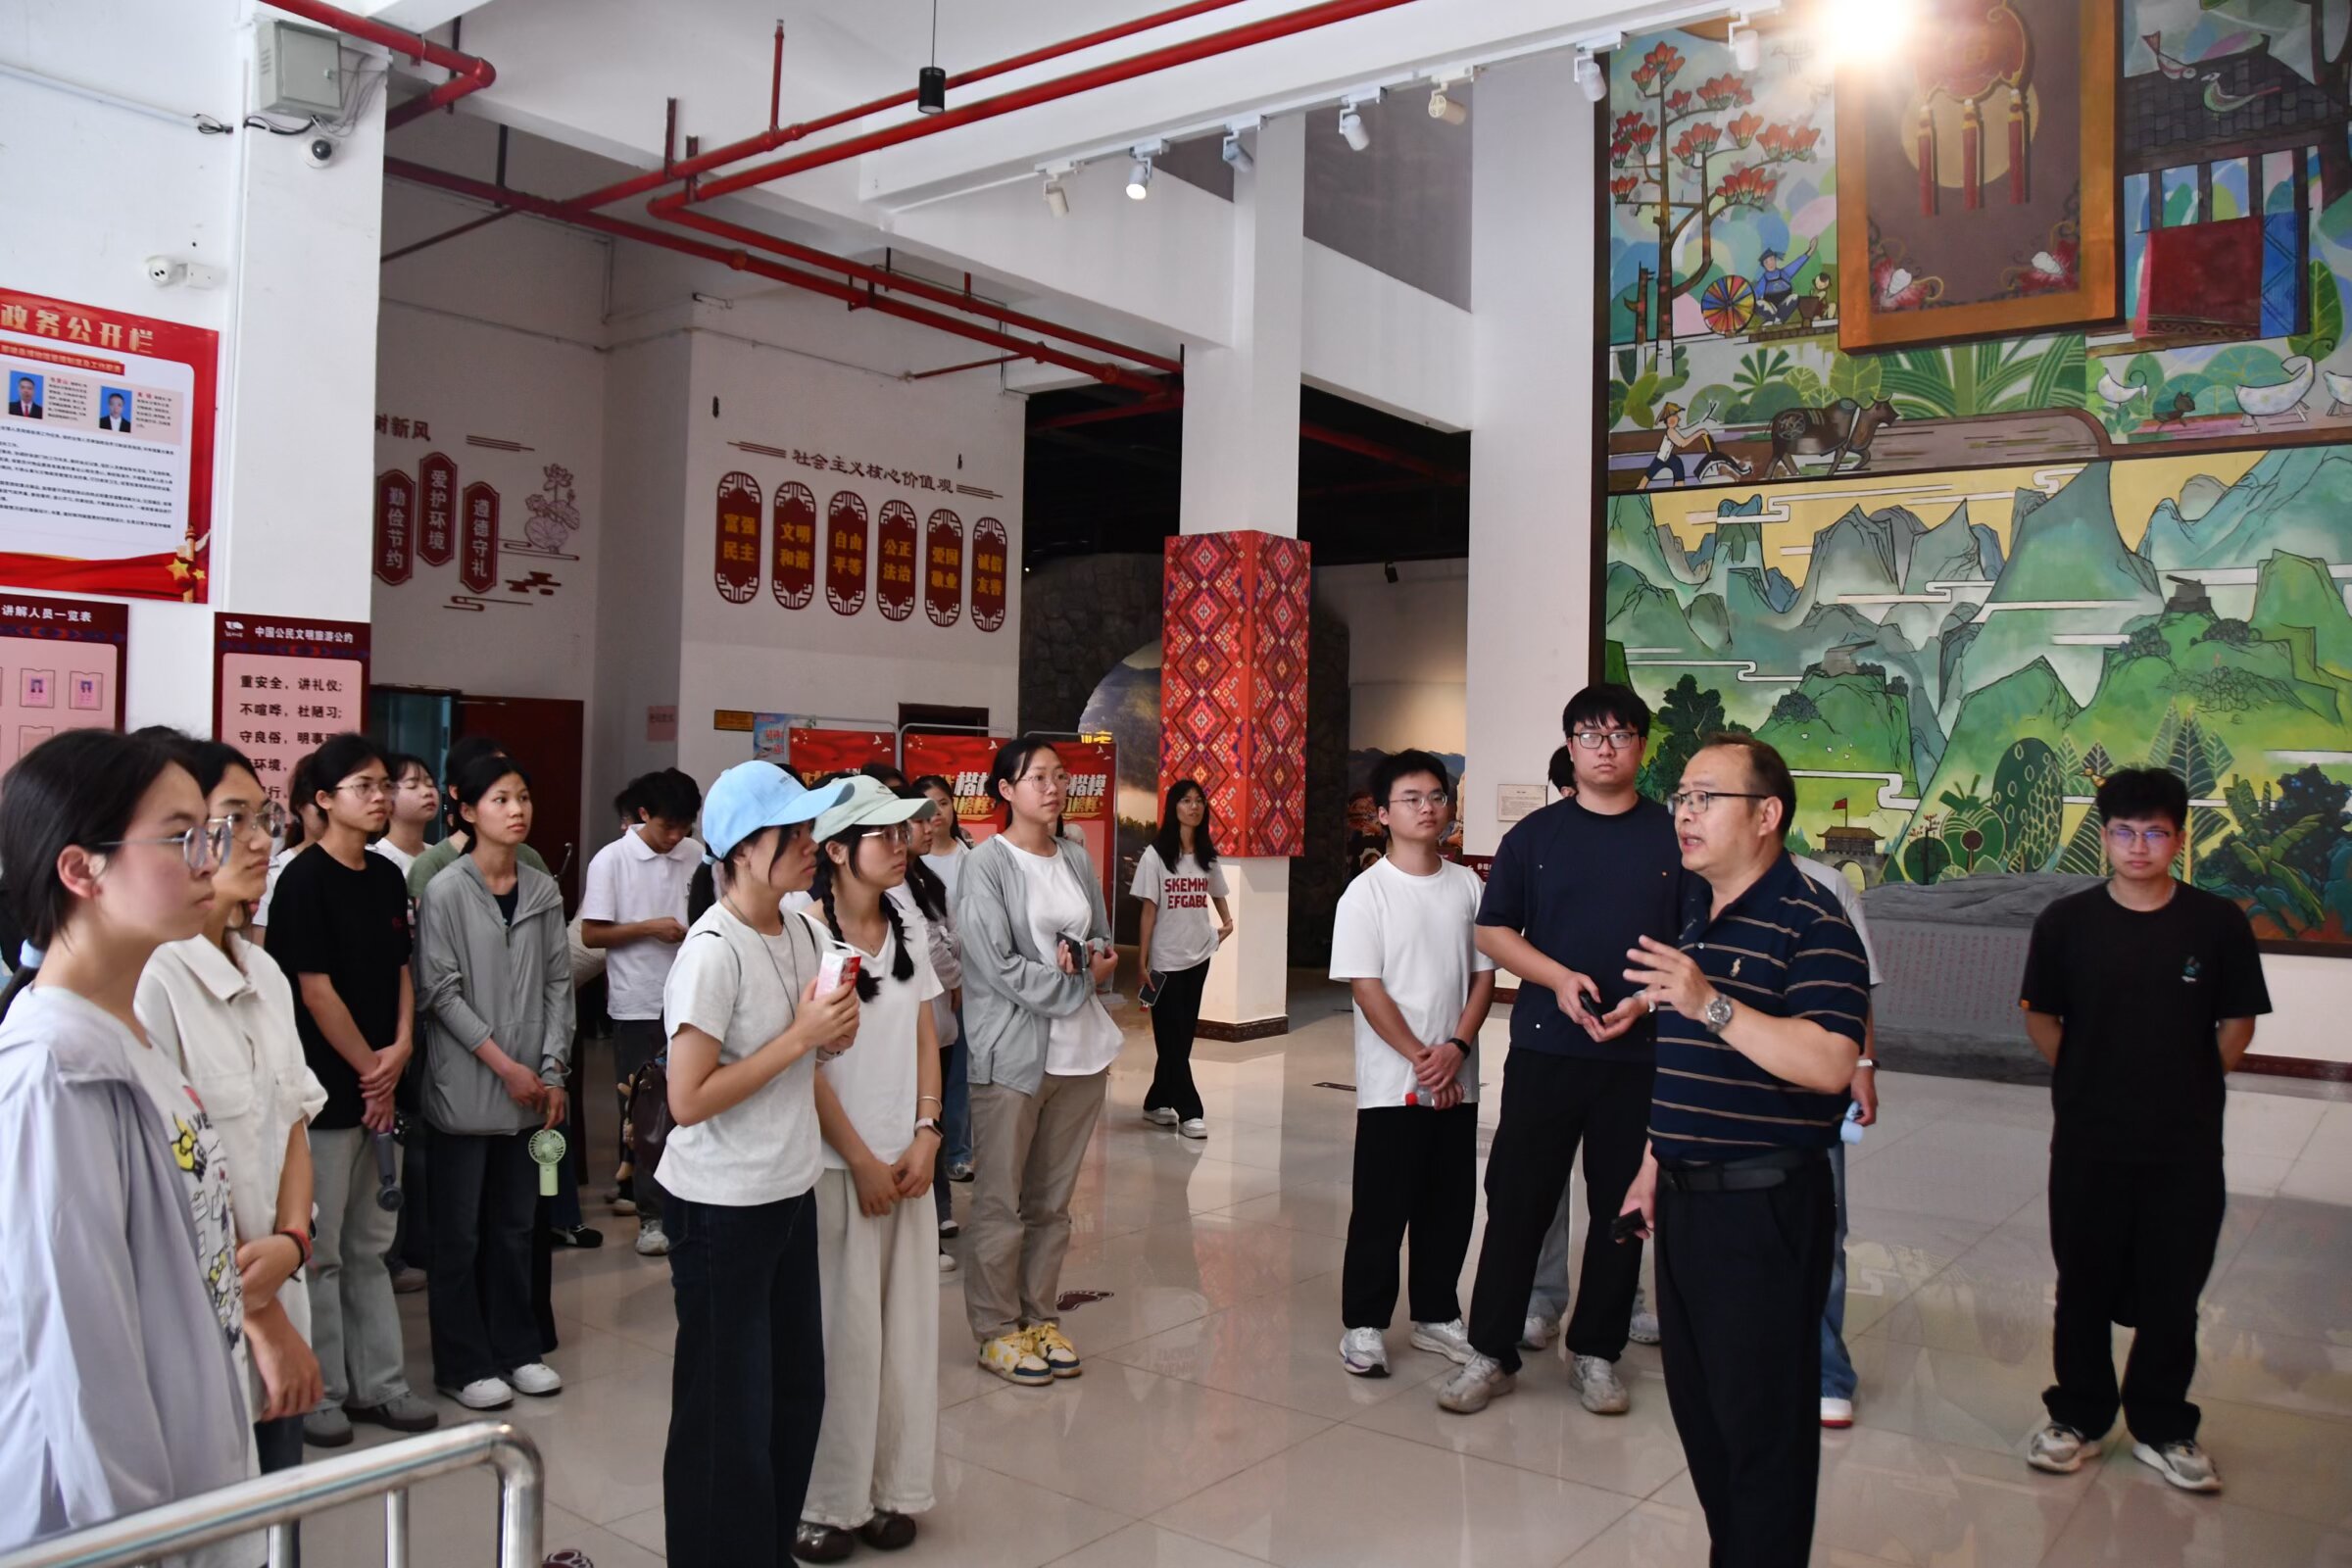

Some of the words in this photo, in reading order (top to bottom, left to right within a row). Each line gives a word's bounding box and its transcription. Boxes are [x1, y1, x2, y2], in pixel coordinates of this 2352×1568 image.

[1, 304, 153, 354] 政务公开栏
[792, 449, 954, 494] 社会主义核心价值观
[427, 469, 448, 550] 爱护环境
[385, 487, 405, 568] 勤俭节约
[724, 514, 756, 535] 富强
[780, 521, 810, 543] 文明
[835, 530, 862, 551] 自由
[884, 538, 911, 558] 公正
[723, 541, 755, 562] 民主
[779, 549, 810, 569] 和谐
[932, 546, 958, 565] 爱国
[833, 556, 862, 576] 平等
[977, 554, 1003, 572] 诚信
[883, 564, 910, 583] 法治
[931, 570, 957, 589] 敬业
[976, 577, 1002, 596] 友善
[2, 604, 92, 623] 讲解人员一览表
[255, 626, 354, 644] 中国公民文明旅游公约
